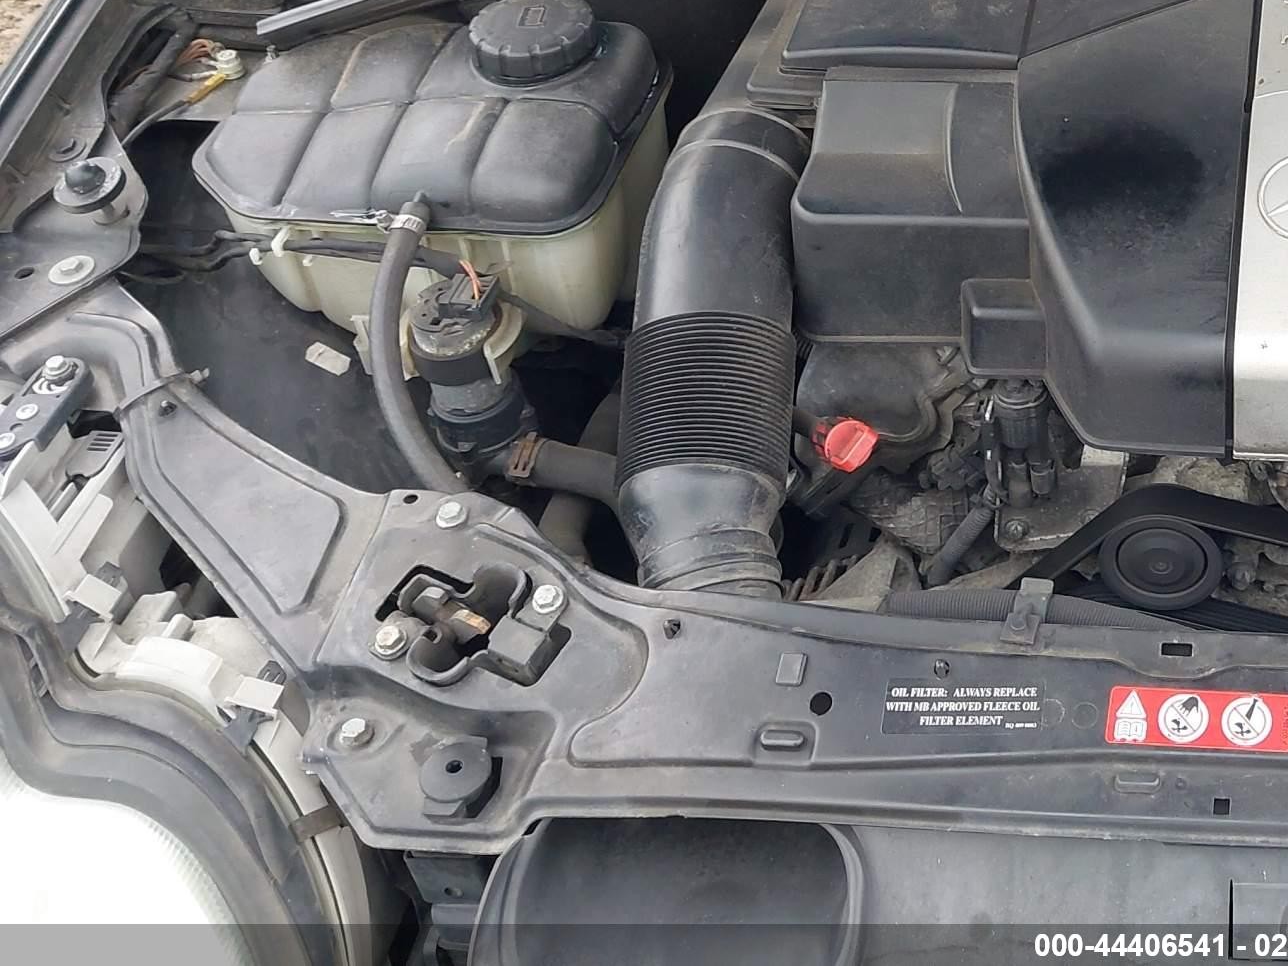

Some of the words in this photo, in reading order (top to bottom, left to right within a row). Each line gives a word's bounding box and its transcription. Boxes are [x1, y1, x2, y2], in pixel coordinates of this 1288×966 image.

[891, 687, 909, 698] OIL
[910, 687, 948, 698] FILTER:
[953, 687, 992, 697] ALWAYS
[993, 687, 1037, 697] REPLACE
[885, 701, 912, 711] WITH
[913, 701, 929, 712] MB
[930, 701, 982, 711] APPROVED
[983, 701, 1021, 711] FLEECE
[1022, 701, 1041, 711] OIL
[919, 715, 954, 726] FILTER
[955, 715, 1003, 726] ELEMENT
